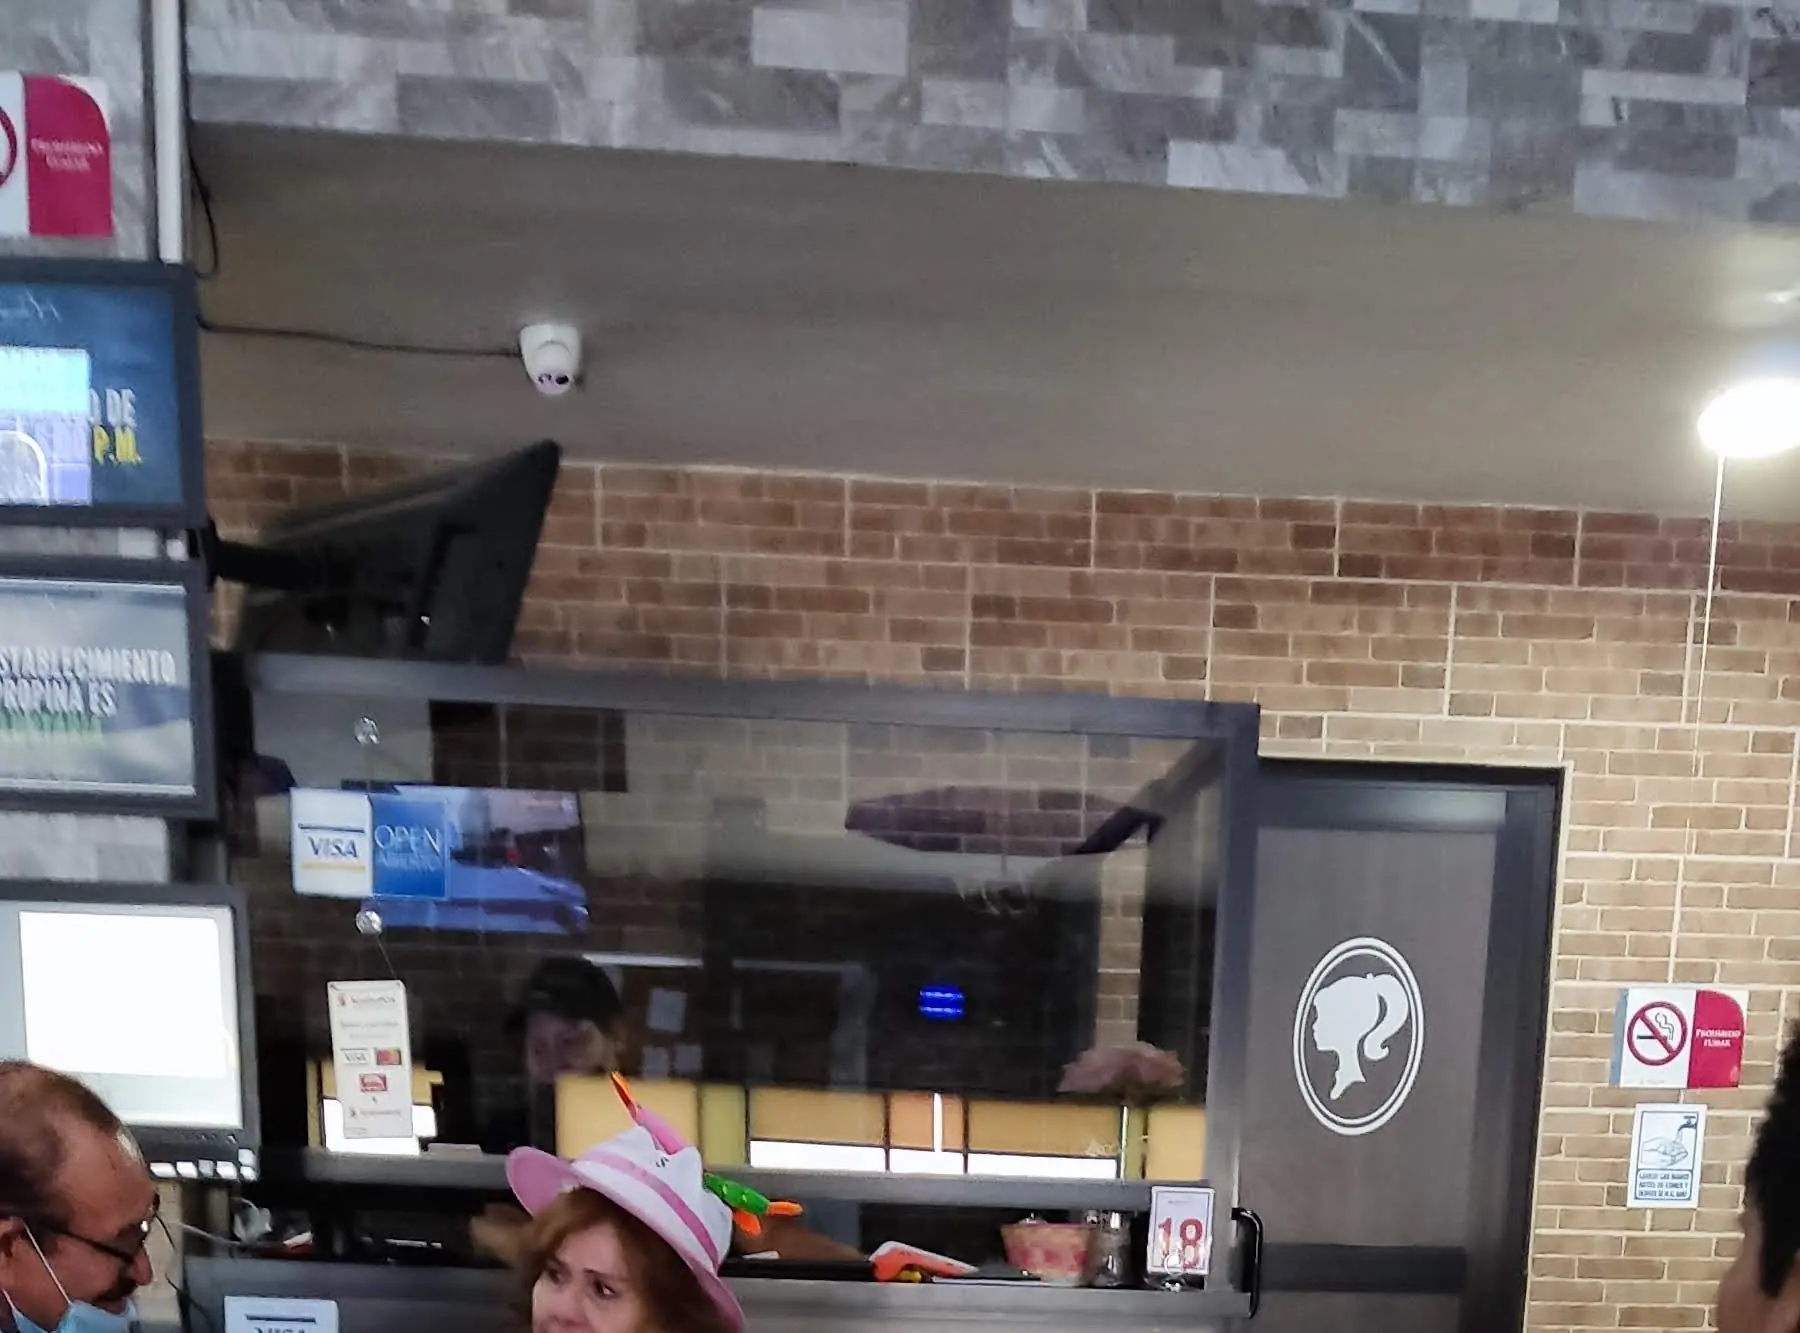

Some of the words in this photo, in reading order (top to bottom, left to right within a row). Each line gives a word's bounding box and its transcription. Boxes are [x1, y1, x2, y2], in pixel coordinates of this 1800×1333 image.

[308, 836, 359, 858] VISA
[375, 825, 443, 862] OPEN
[1158, 1217, 1203, 1269] 18
